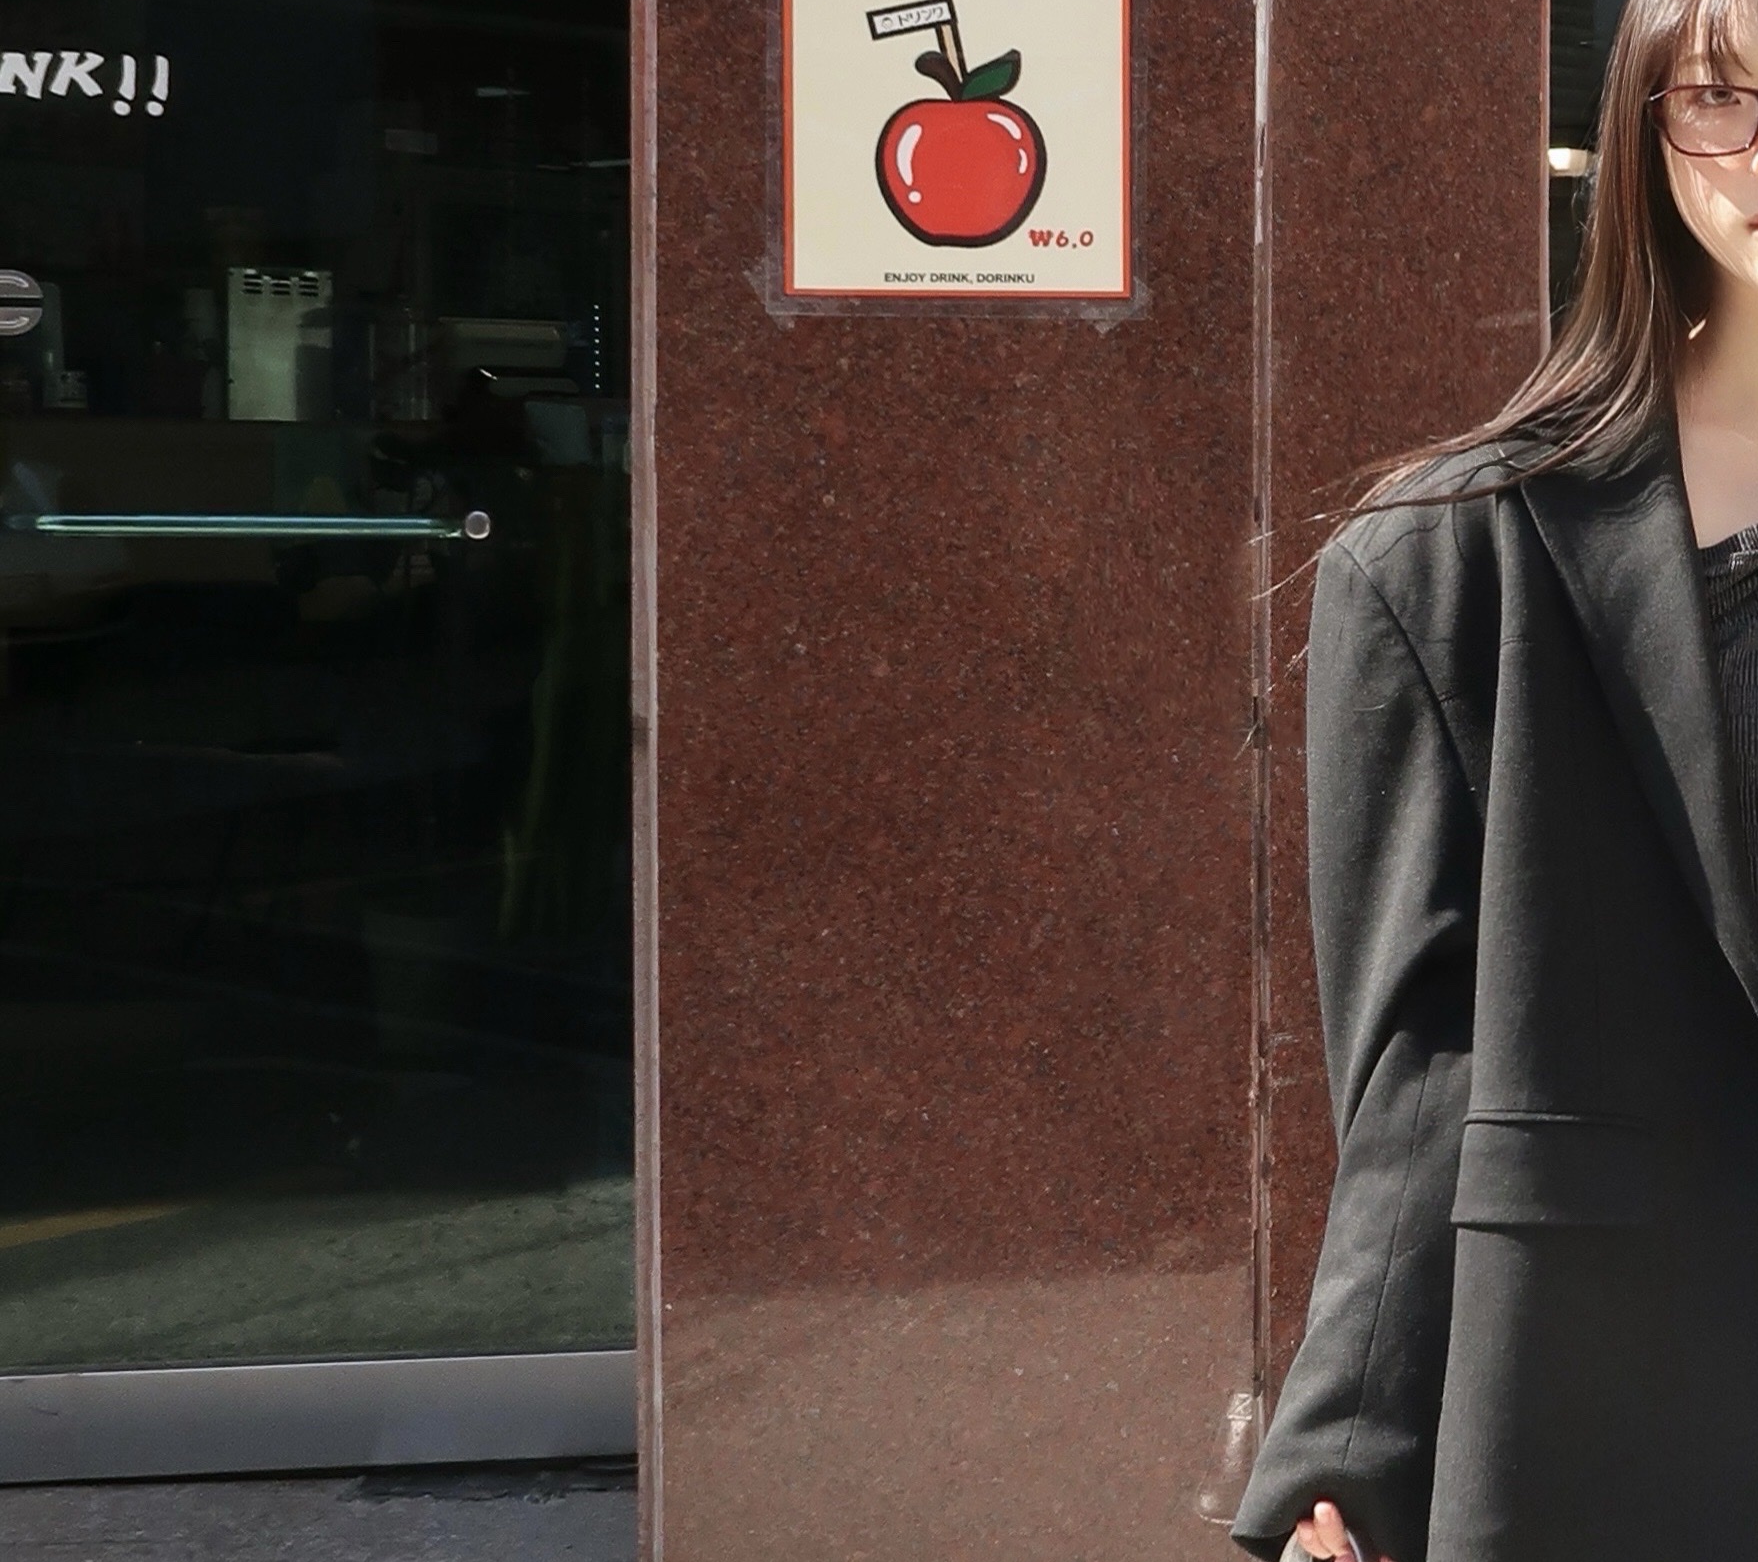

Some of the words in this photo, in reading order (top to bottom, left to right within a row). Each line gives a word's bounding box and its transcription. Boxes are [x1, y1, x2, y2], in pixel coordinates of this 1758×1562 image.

[897, 5, 944, 27] ドリンク
[884, 271, 926, 284] ENJOY
[929, 272, 973, 285] DRINK,
[976, 273, 1035, 284] DORINKU
